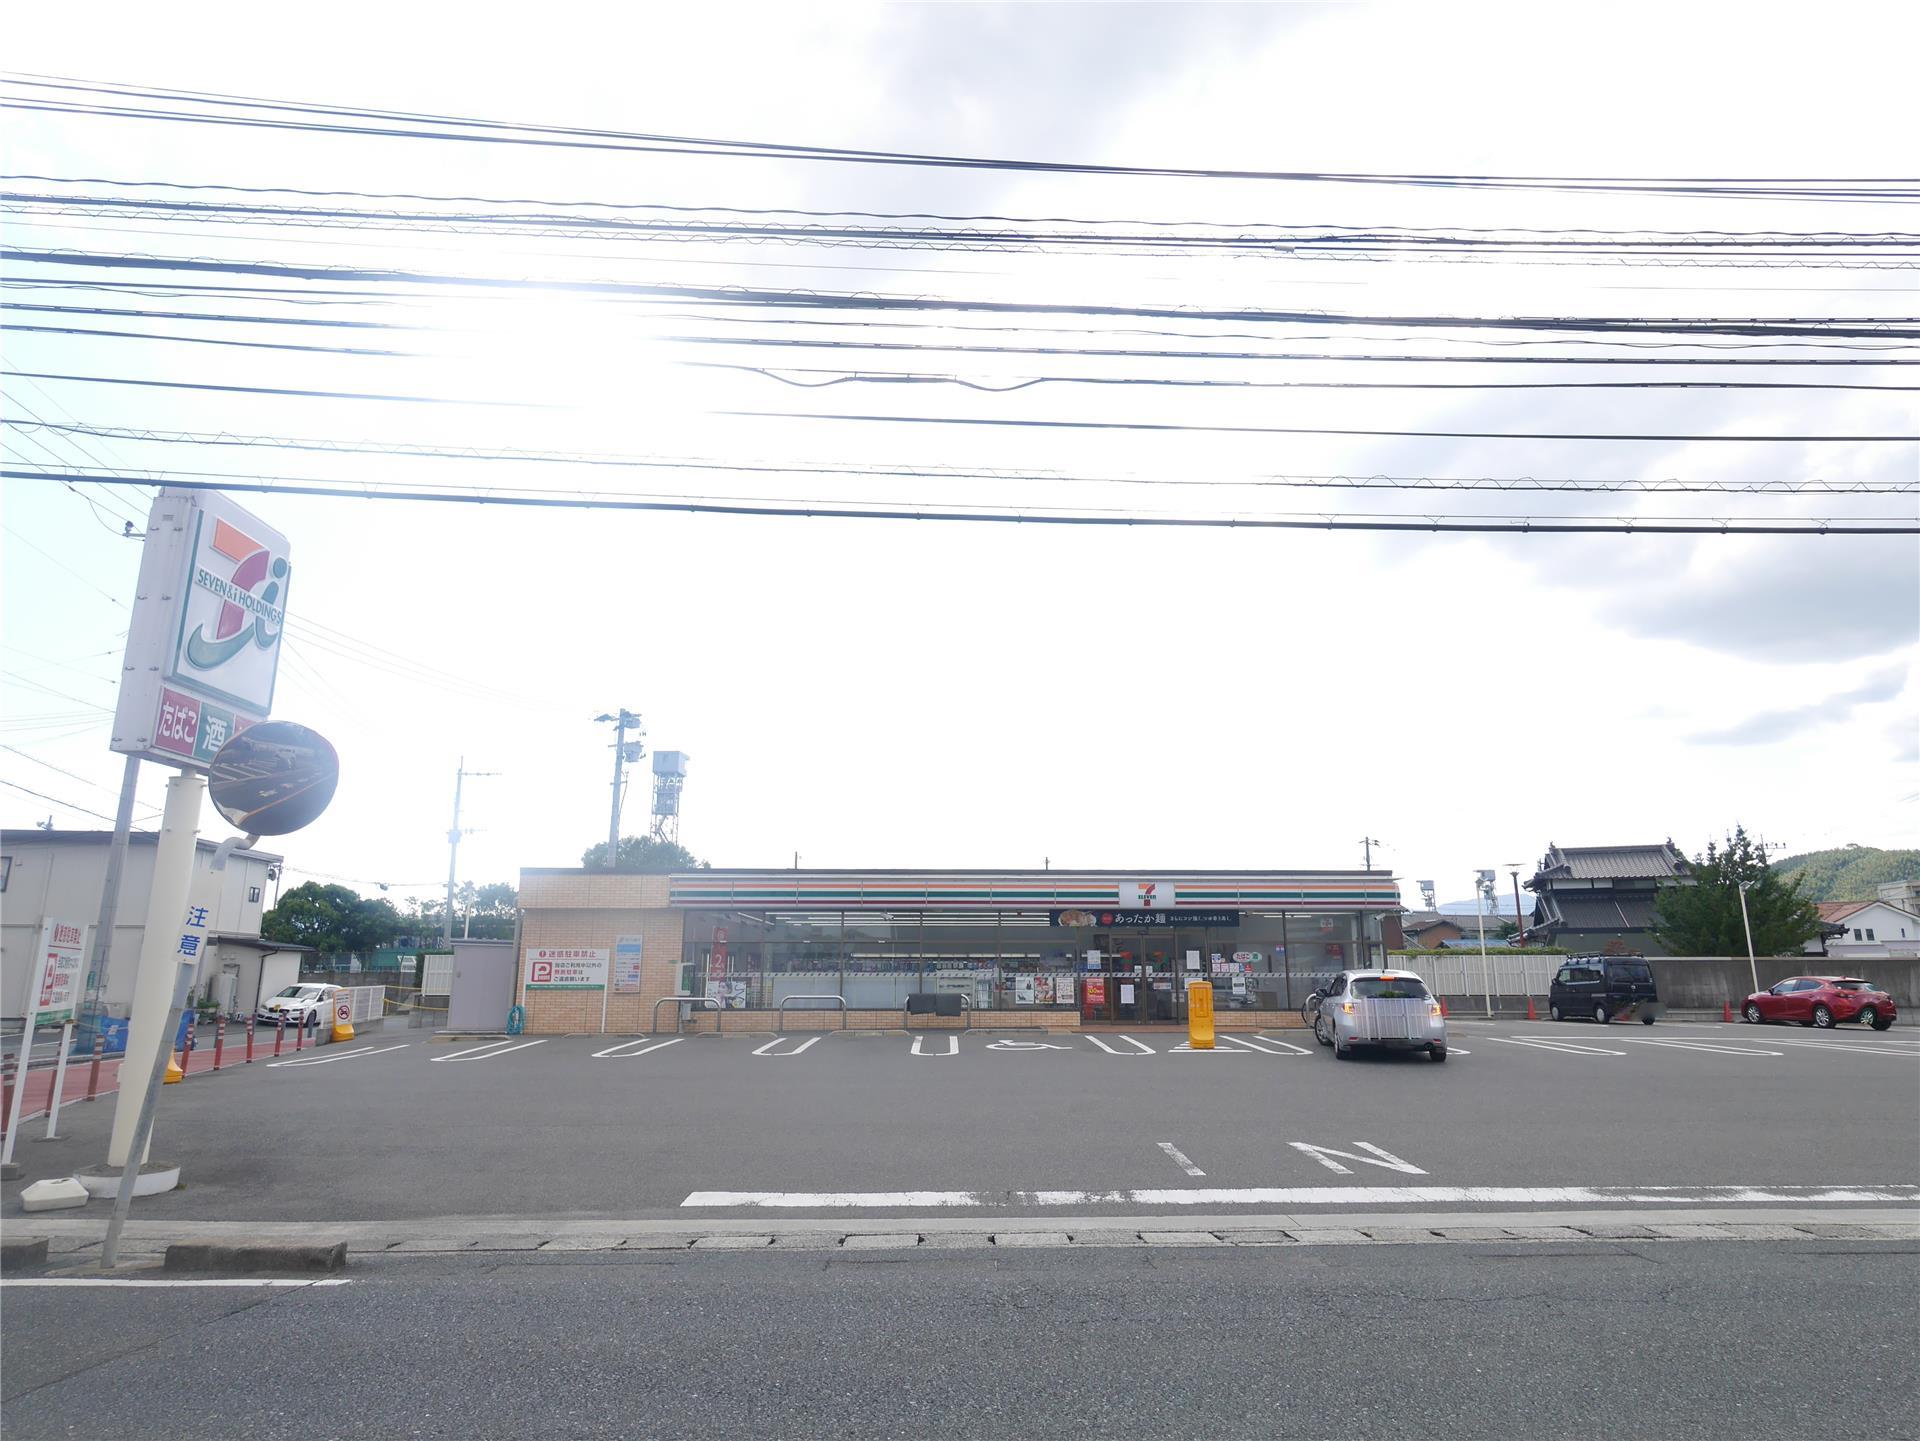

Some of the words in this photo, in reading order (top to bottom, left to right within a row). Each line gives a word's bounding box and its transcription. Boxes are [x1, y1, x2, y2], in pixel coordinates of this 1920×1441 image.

[198, 568, 238, 602] SEVEN&i
[239, 590, 282, 625] HOLDINGS
[159, 702, 197, 743] たばこ
[203, 716, 227, 752] 酒
[177, 906, 208, 956] 注意
[1115, 913, 1166, 924] あったか麺
[549, 950, 596, 958] 迷惑駐車禁止
[1156, 1142, 1430, 1176] IN
